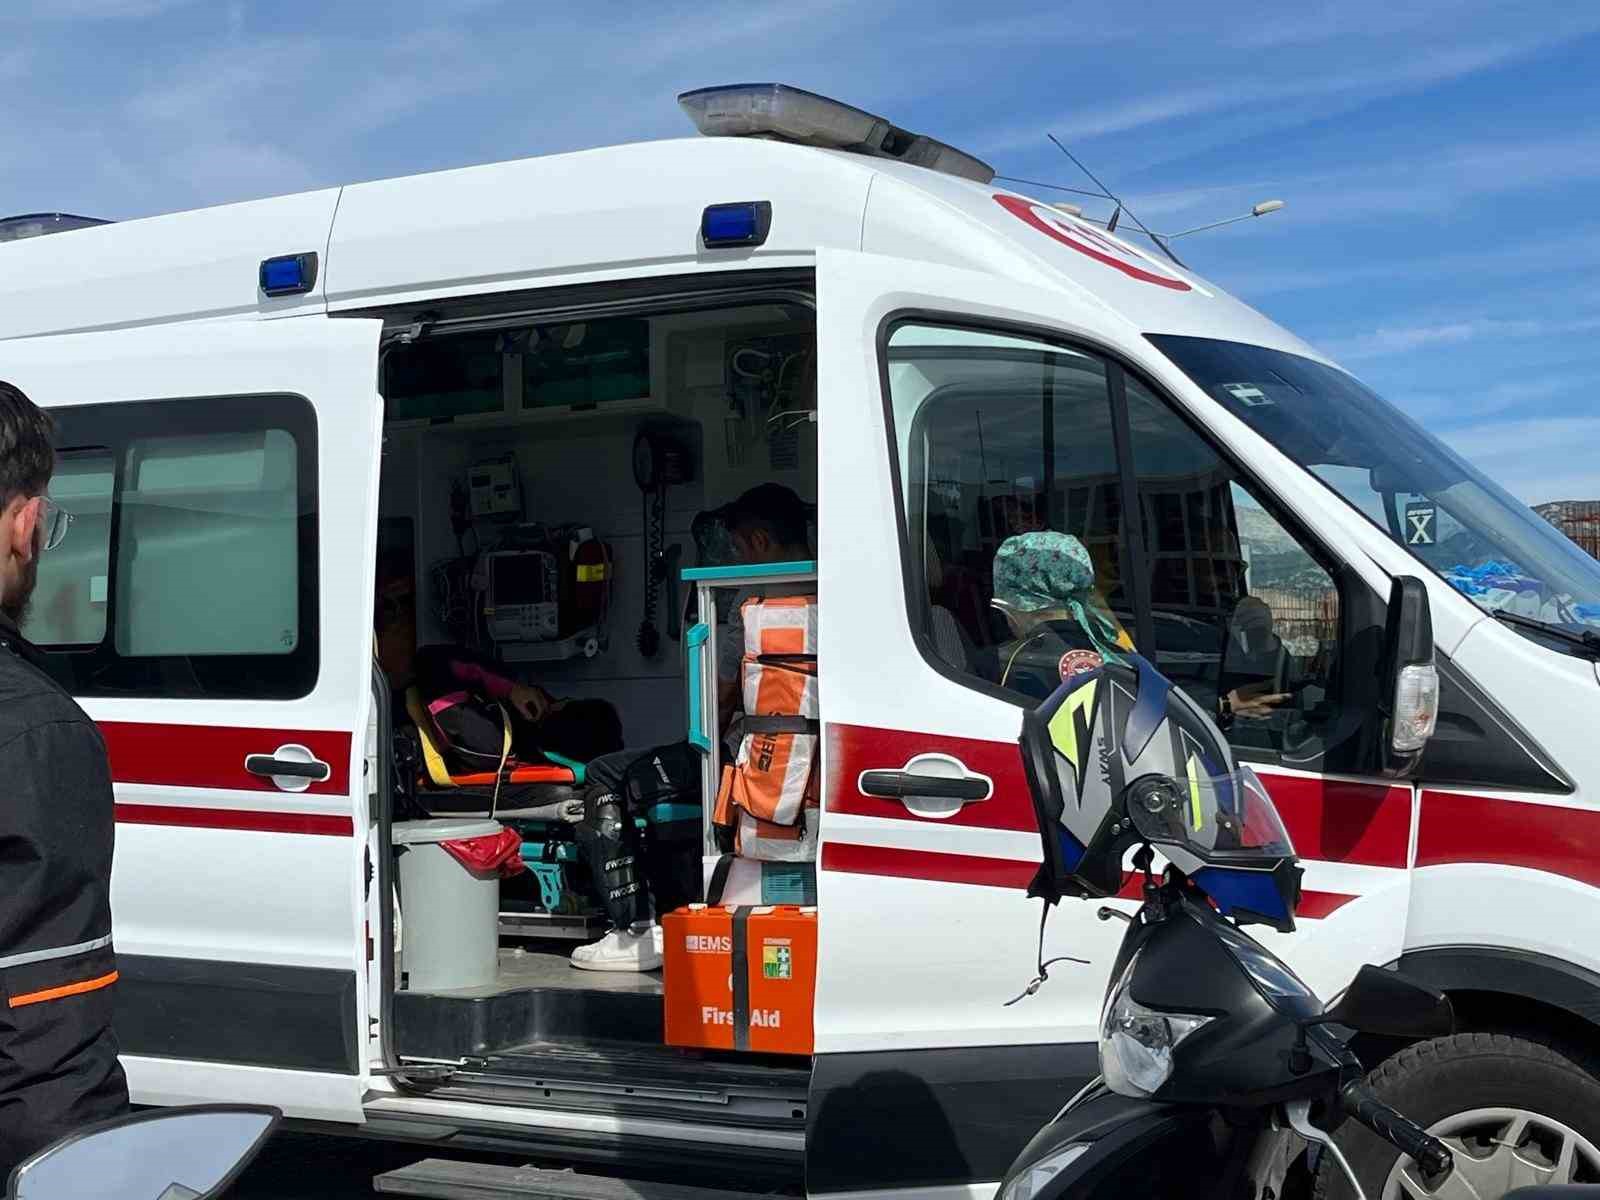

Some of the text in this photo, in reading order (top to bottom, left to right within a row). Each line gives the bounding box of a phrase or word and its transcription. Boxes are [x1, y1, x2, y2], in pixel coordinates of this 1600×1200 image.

[699, 936, 731, 951] EMS
[702, 1007, 780, 1028] Firs Aid
